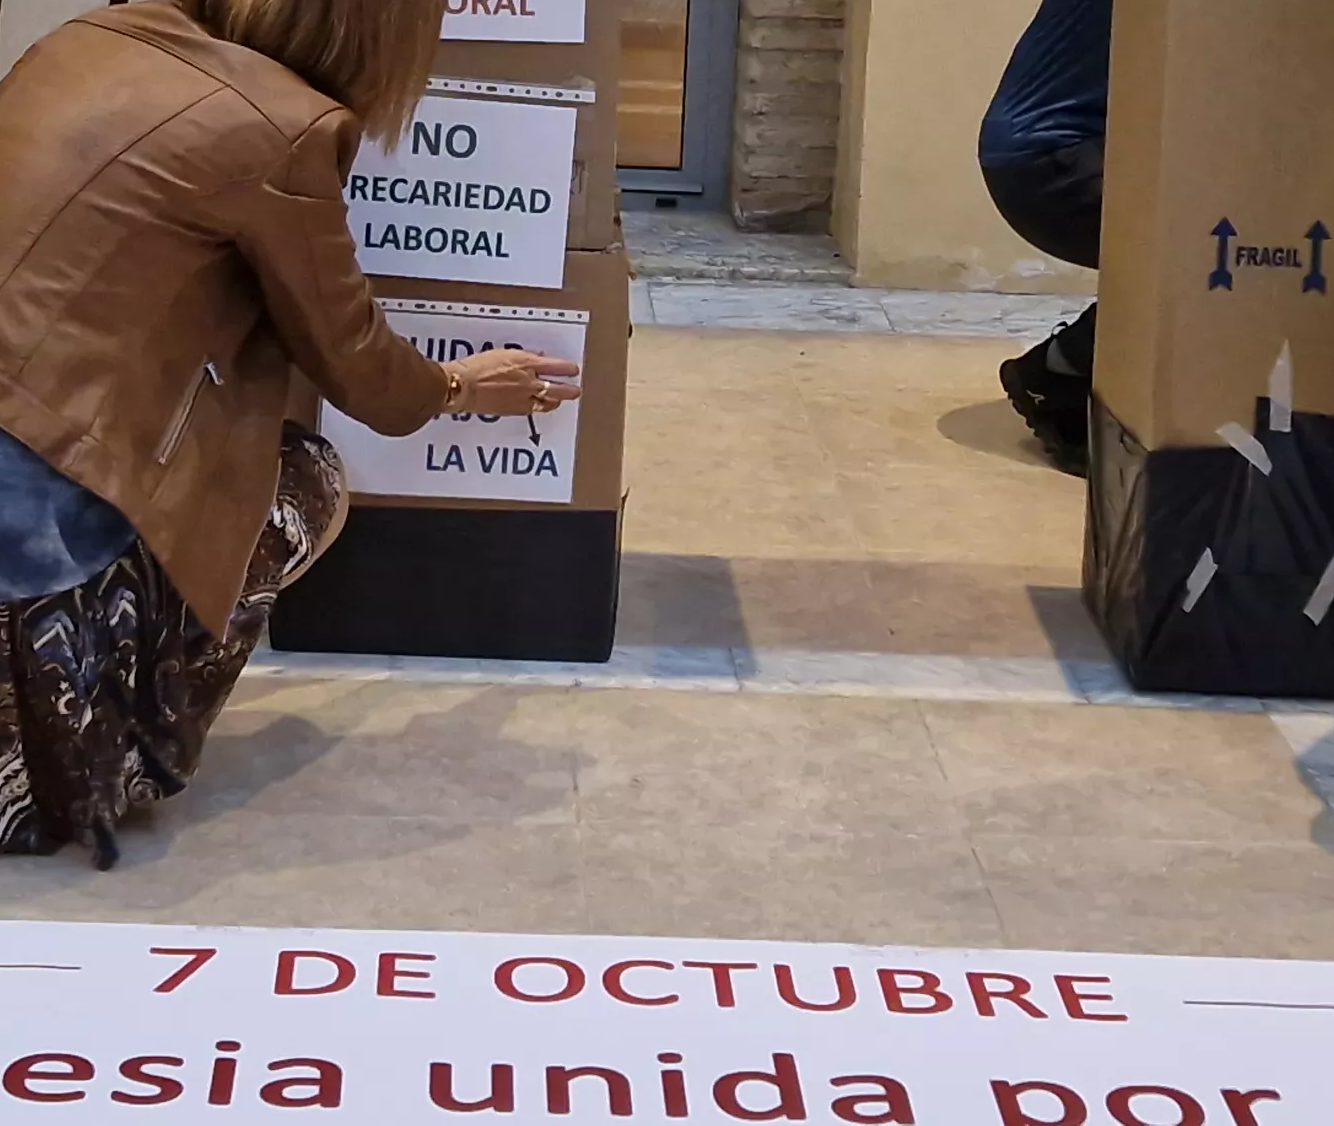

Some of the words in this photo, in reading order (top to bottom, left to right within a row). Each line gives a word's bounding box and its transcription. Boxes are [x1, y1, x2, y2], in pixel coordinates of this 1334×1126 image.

[411, 121, 478, 160] NO
[349, 174, 552, 215] RECARIEDAD
[364, 222, 510, 258] LABORAL
[1236, 246, 1303, 268] FRAGIL
[426, 443, 465, 473] LA
[476, 445, 559, 477] VIDA
[149, 947, 217, 993] 7
[273, 950, 437, 999] DE
[493, 955, 1129, 1022] OCTUBRE
[428, 1052, 917, 1125] unida
